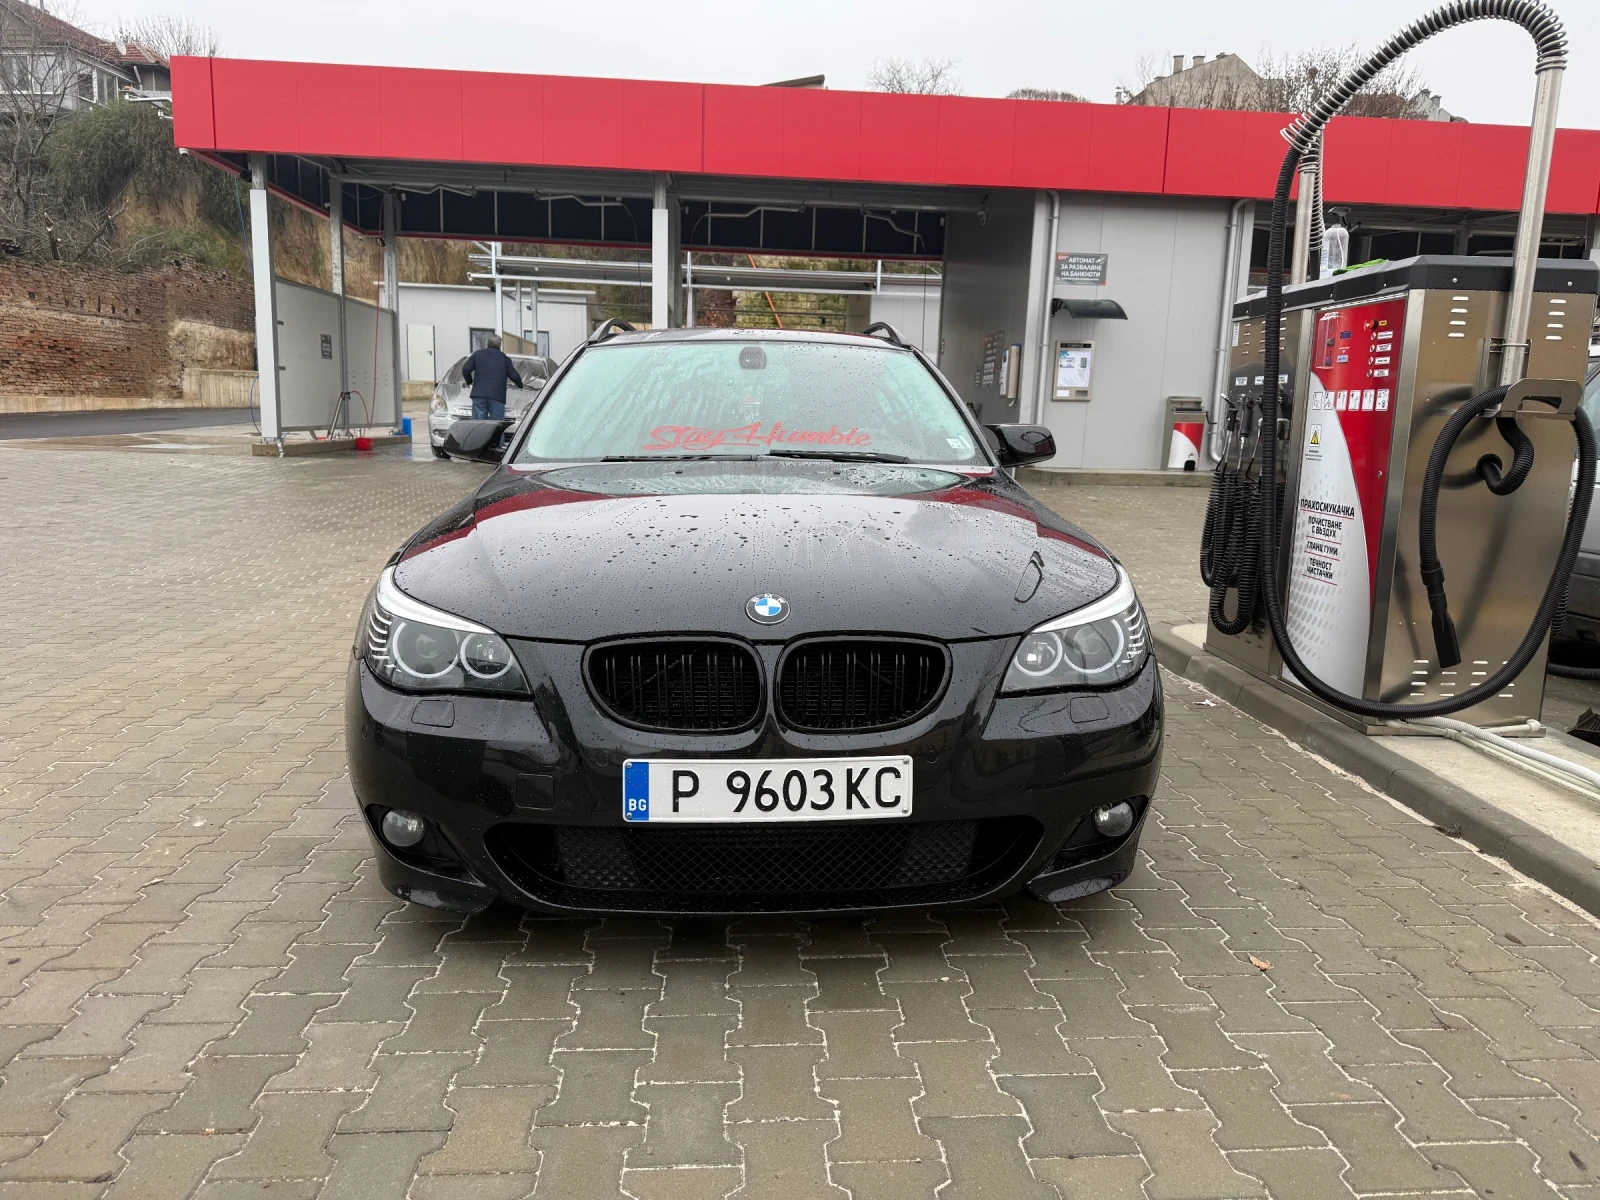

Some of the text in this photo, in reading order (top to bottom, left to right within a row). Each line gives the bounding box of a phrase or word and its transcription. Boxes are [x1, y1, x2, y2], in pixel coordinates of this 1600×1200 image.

[643, 421, 872, 450] Stay Humble
[1300, 499, 1355, 517] ПРАХОСМУКАЧКА
[1308, 516, 1343, 530] ПОЧИСТВАНЕ
[1306, 541, 1338, 556] ГЛАНЦ ГУМИ
[1309, 557, 1332, 570] ТЕЧНОСТ
[1306, 566, 1333, 580] ЧИСТАЧКИ
[672, 770, 699, 812] P
[628, 798, 647, 811] BG
